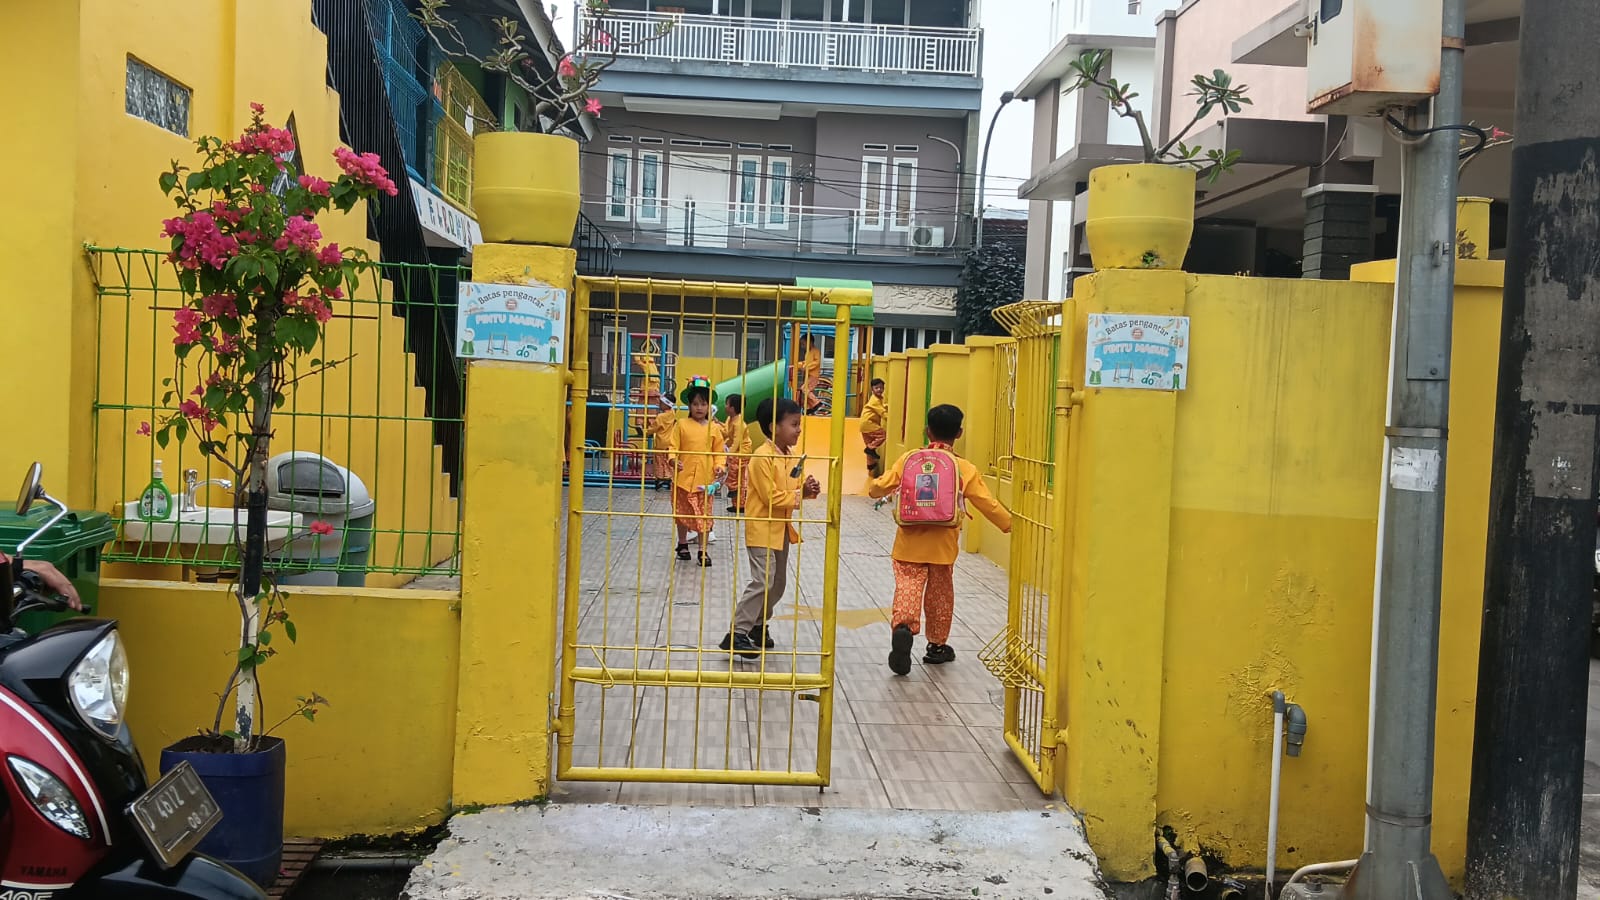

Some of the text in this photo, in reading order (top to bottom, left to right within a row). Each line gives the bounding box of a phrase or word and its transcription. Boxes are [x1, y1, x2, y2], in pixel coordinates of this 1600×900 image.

[478, 290, 501, 304] Batas
[502, 290, 545, 308] pengantar
[475, 313, 507, 325] PINTU
[1105, 320, 1128, 335] Batas
[1129, 319, 1169, 337] pengantar
[516, 346, 530, 358] do
[1103, 343, 1133, 355] PINTU
[1141, 373, 1154, 386] do
[21, 865, 67, 877] YAMAHA
